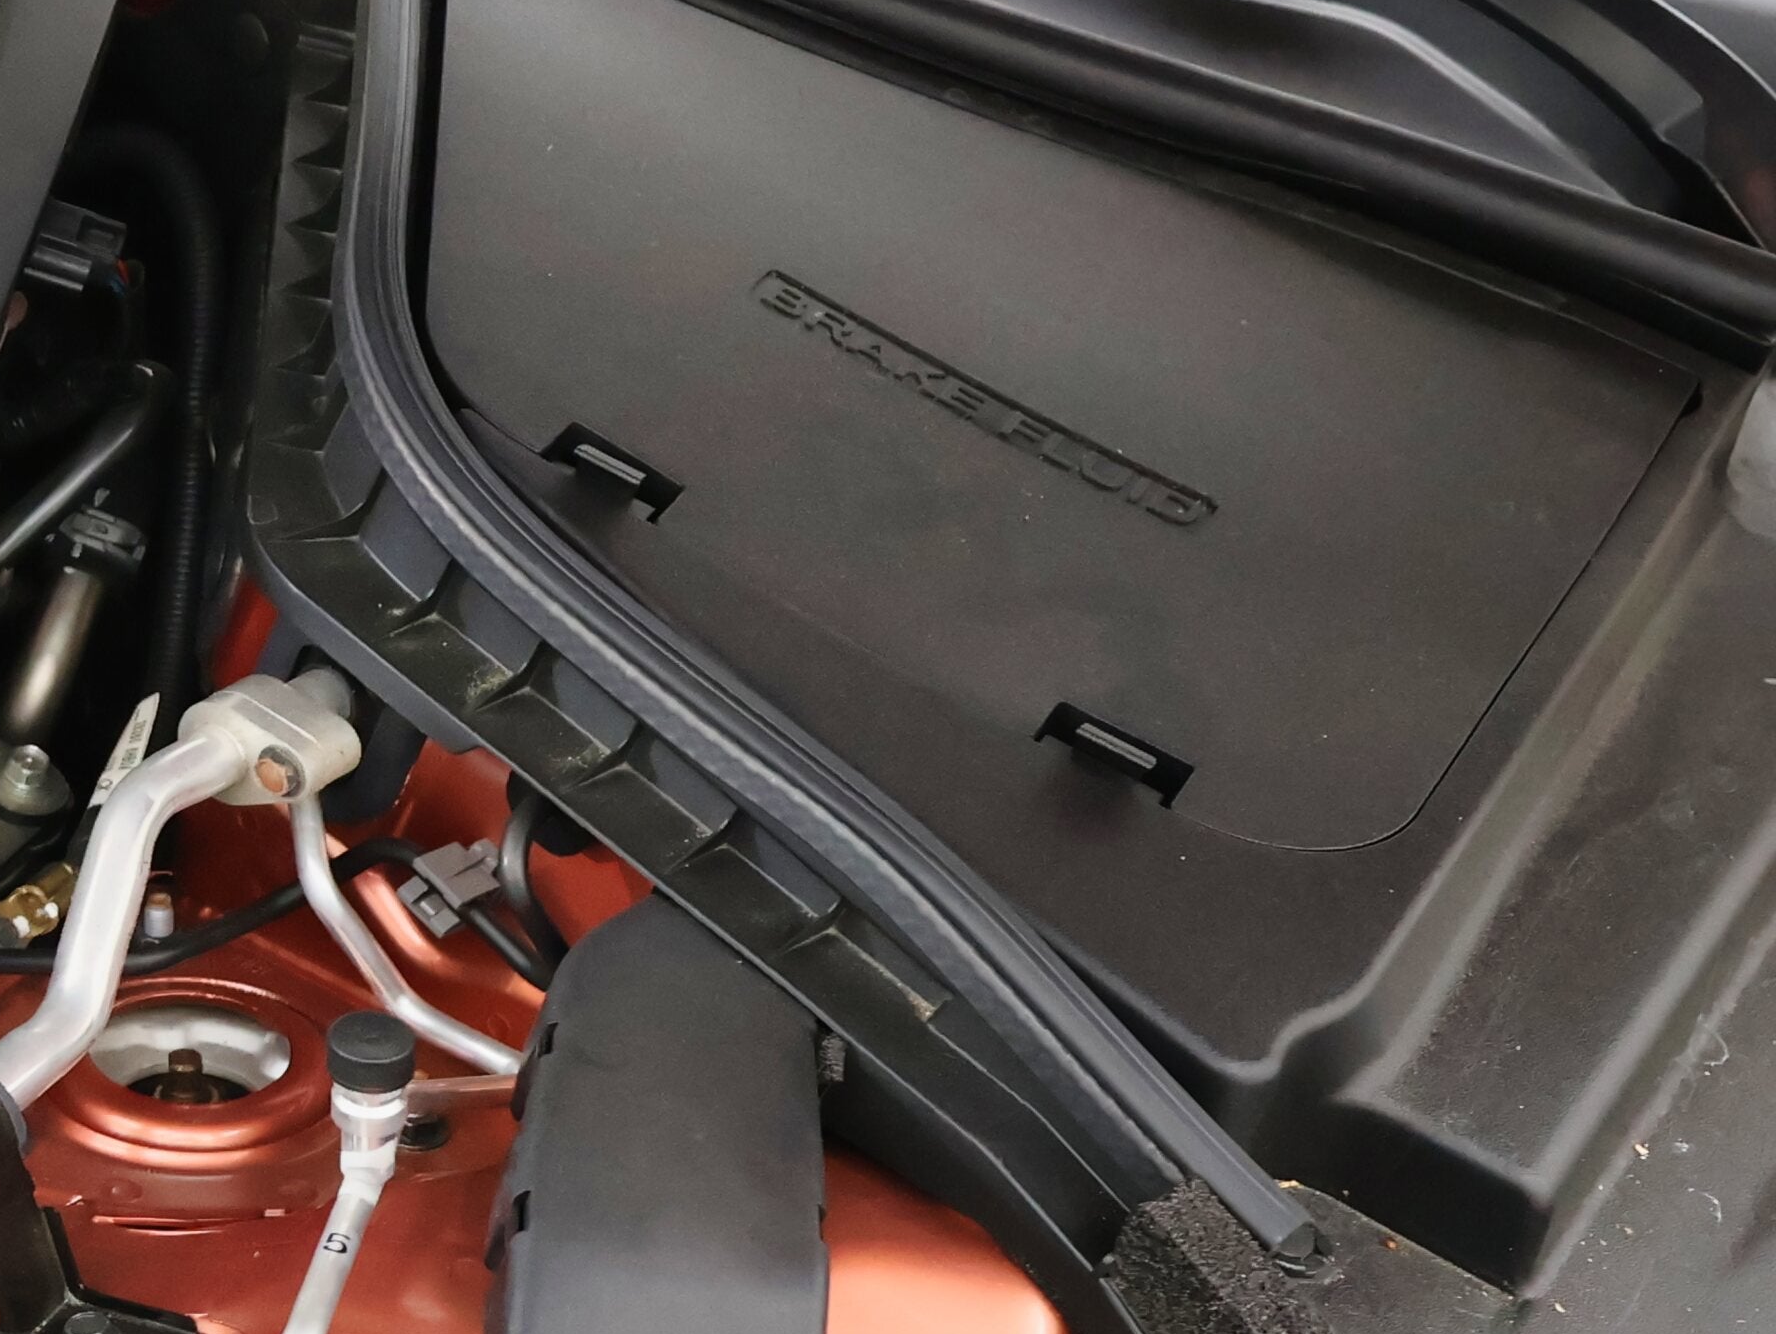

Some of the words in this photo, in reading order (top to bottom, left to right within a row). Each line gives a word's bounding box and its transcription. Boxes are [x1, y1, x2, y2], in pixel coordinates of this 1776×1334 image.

[758, 283, 989, 423] BRAKE
[998, 411, 1212, 527] FLUID
[322, 1232, 351, 1254] 5
